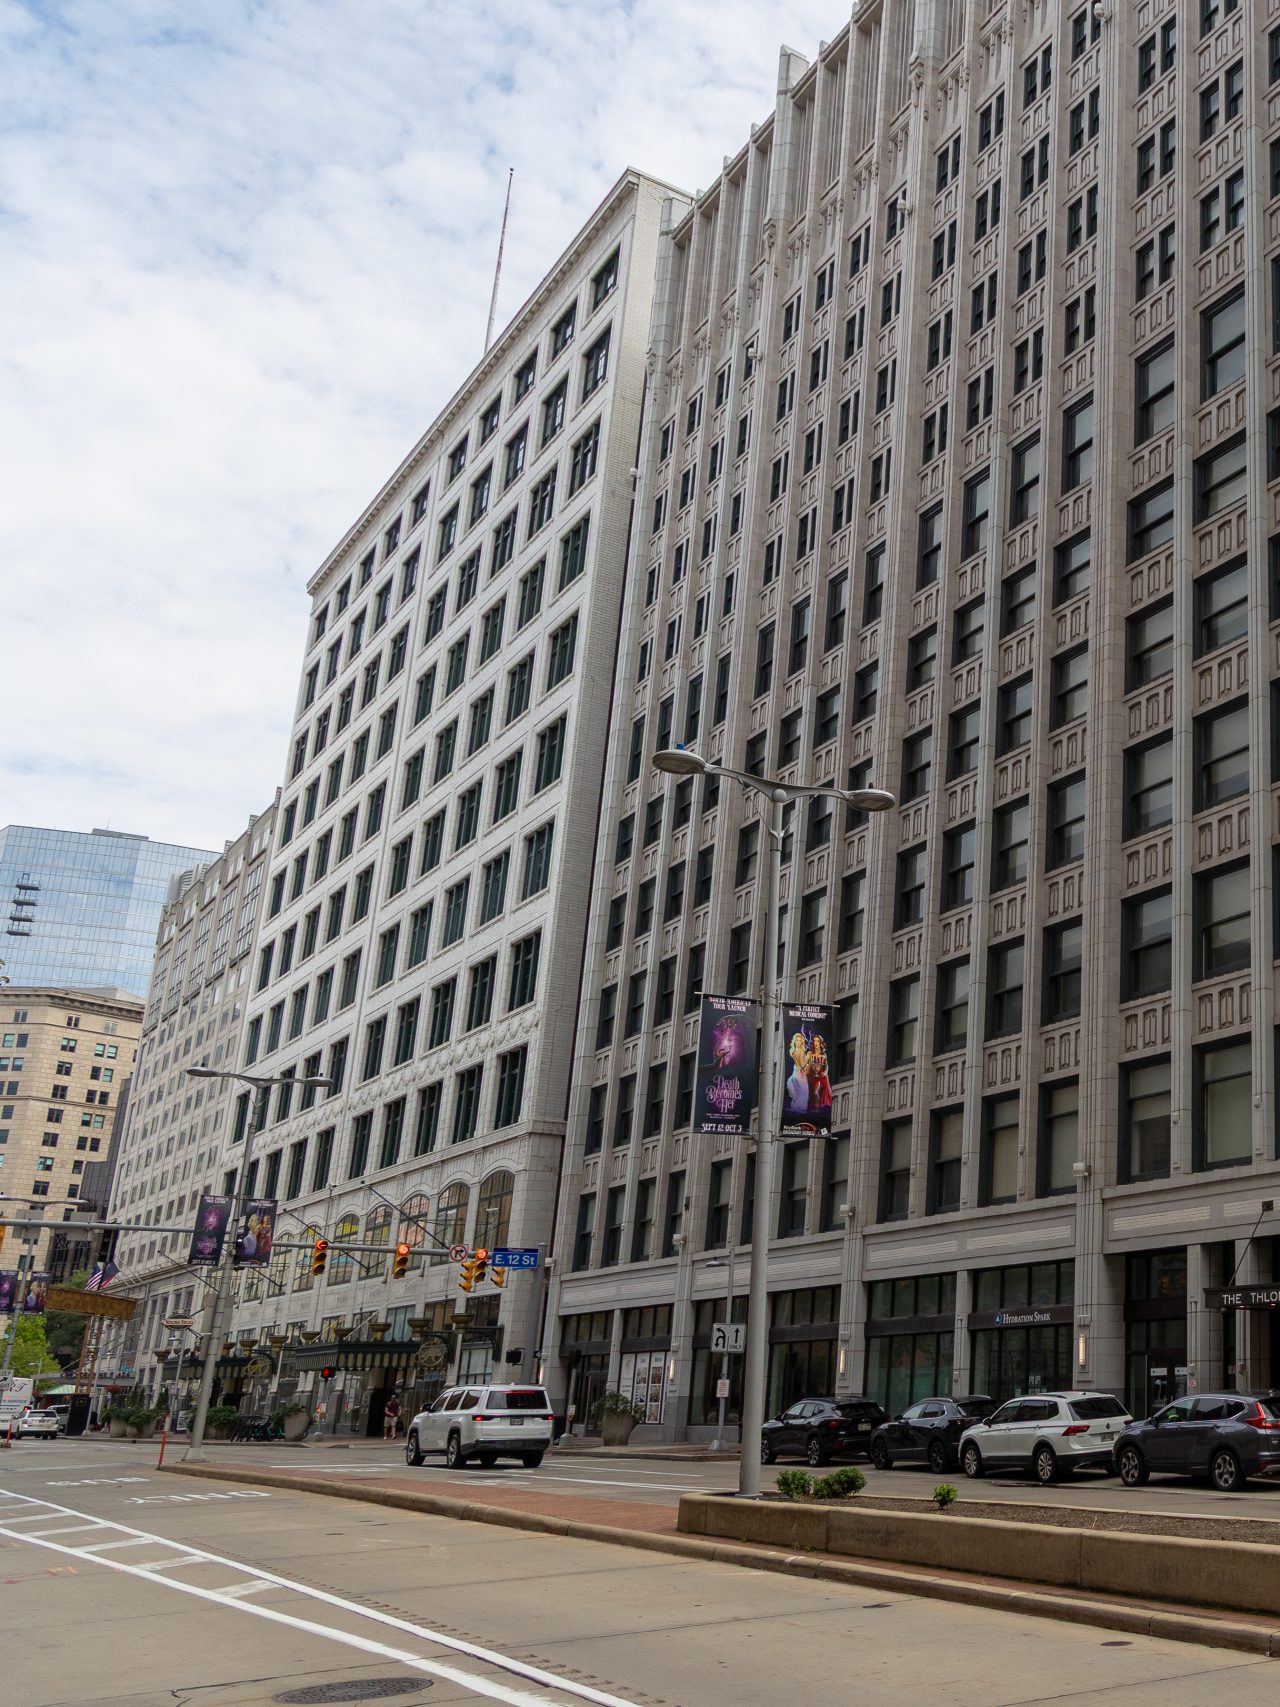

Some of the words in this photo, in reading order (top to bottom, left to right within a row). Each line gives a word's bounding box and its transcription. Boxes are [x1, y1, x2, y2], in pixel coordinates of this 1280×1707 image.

[713, 1074, 740, 1090] Death
[705, 1085, 742, 1103] Becomes
[716, 1098, 737, 1113] Her
[701, 1122, 716, 1133] SEPT
[495, 1254, 505, 1265] E.
[507, 1254, 519, 1265] 12
[522, 1254, 535, 1266] St
[1222, 1293, 1242, 1305] THE
[1002, 1313, 1033, 1324] HYDRATION
[1033, 1311, 1051, 1322] SPARK
[126, 1490, 273, 1504] ONLY
